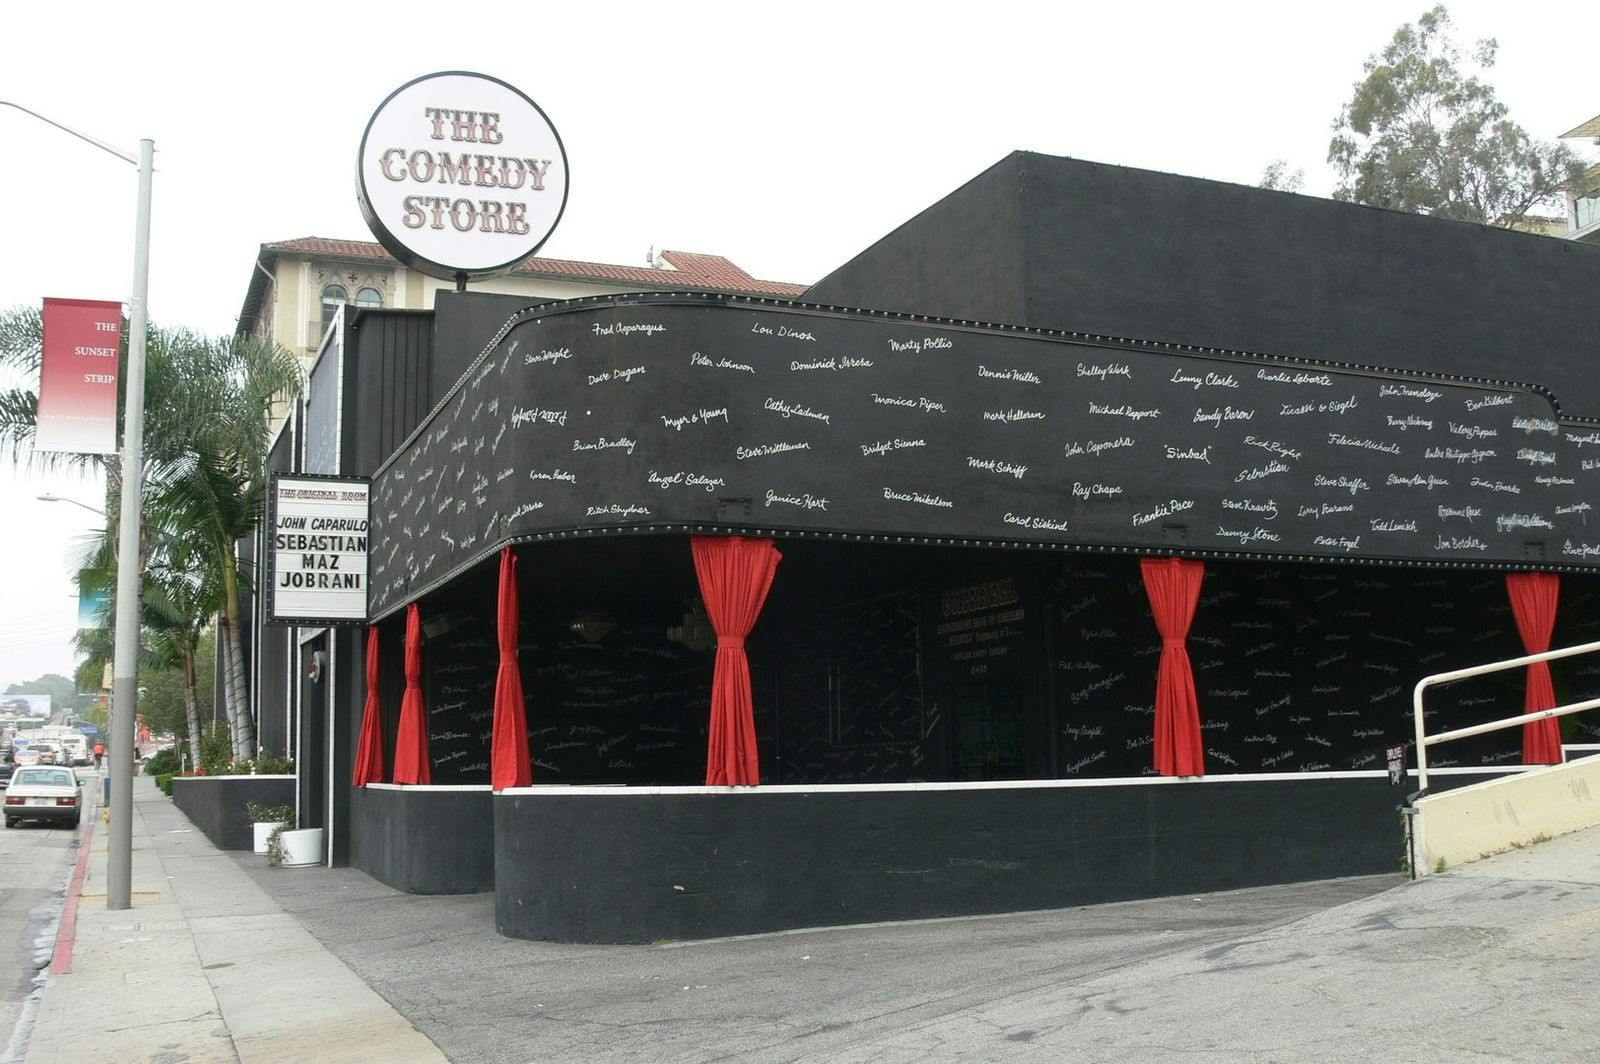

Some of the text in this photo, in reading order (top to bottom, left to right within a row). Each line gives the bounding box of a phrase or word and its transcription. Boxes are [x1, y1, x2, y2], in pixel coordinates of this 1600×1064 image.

[424, 106, 504, 145] THE
[378, 147, 552, 191] COMEDY
[401, 194, 531, 236] STORE
[94, 321, 117, 332] THE
[592, 322, 667, 336] Fred Asparagus
[752, 322, 773, 334] Lou
[74, 345, 117, 358] SUNSET
[888, 339, 921, 354] Marty
[541, 348, 573, 364] Wright
[691, 352, 756, 374] Peter Johnson
[83, 373, 116, 385] STRIP
[977, 365, 1042, 385] Dennis Miller
[1076, 362, 1108, 382] Shelley
[1170, 368, 1241, 391] Lenny Clarke
[1379, 384, 1443, 404] John Mendoza
[764, 398, 793, 420] Cathy
[871, 393, 948, 414] Monica Piper
[1088, 401, 1125, 416] Michael
[699, 407, 730, 425] Young
[983, 407, 1047, 424] Mark Halloran
[1192, 406, 1256, 429] Sandy Baron
[598, 437, 638, 455] Bradley
[737, 446, 762, 461] Steve
[860, 440, 893, 456] Bridget
[1065, 441, 1085, 458] John
[966, 456, 1028, 480] Mark Schiff
[1314, 475, 1340, 488] Steve
[882, 486, 912, 501] Bruce
[1072, 481, 1091, 501] Ray
[765, 489, 831, 512] Janice Hart
[1131, 498, 1194, 526] Frankie Pace
[277, 516, 369, 532] JOHN CAPARULO
[1003, 512, 1068, 531] Carol Siskind
[1369, 517, 1390, 533] Todd
[276, 534, 367, 552] SEBASTIAN
[1215, 525, 1281, 544] Danny Stone
[302, 553, 339, 570] MAZ
[280, 572, 361, 590] JOBRANI
